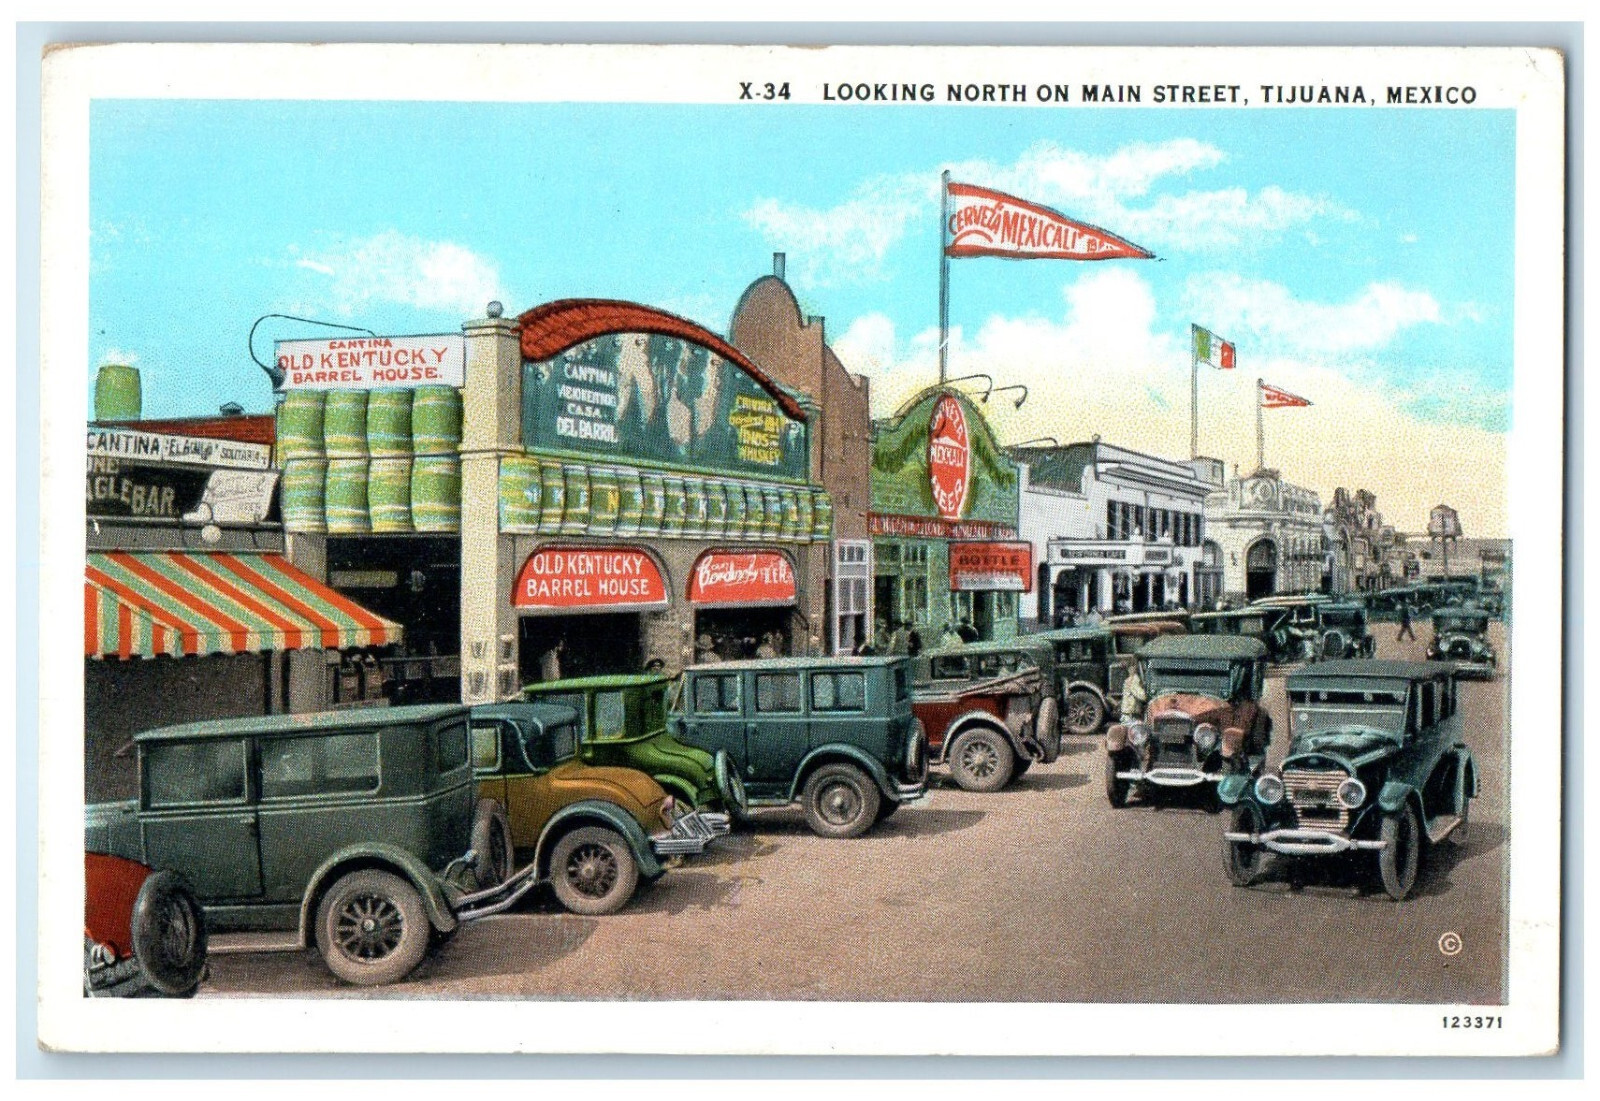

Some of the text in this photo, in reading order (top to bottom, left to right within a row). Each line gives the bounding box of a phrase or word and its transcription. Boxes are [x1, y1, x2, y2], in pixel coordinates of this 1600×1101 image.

[329, 338, 392, 350] CANTINA
[278, 347, 448, 370] OLD KENTUCKY
[293, 370, 362, 385] BARREL
[564, 362, 615, 387] CANTINA
[87, 432, 160, 455] CANTINA
[533, 554, 642, 575] OLD KENTUCKY
[526, 578, 650, 598] BARREL HOUSE
